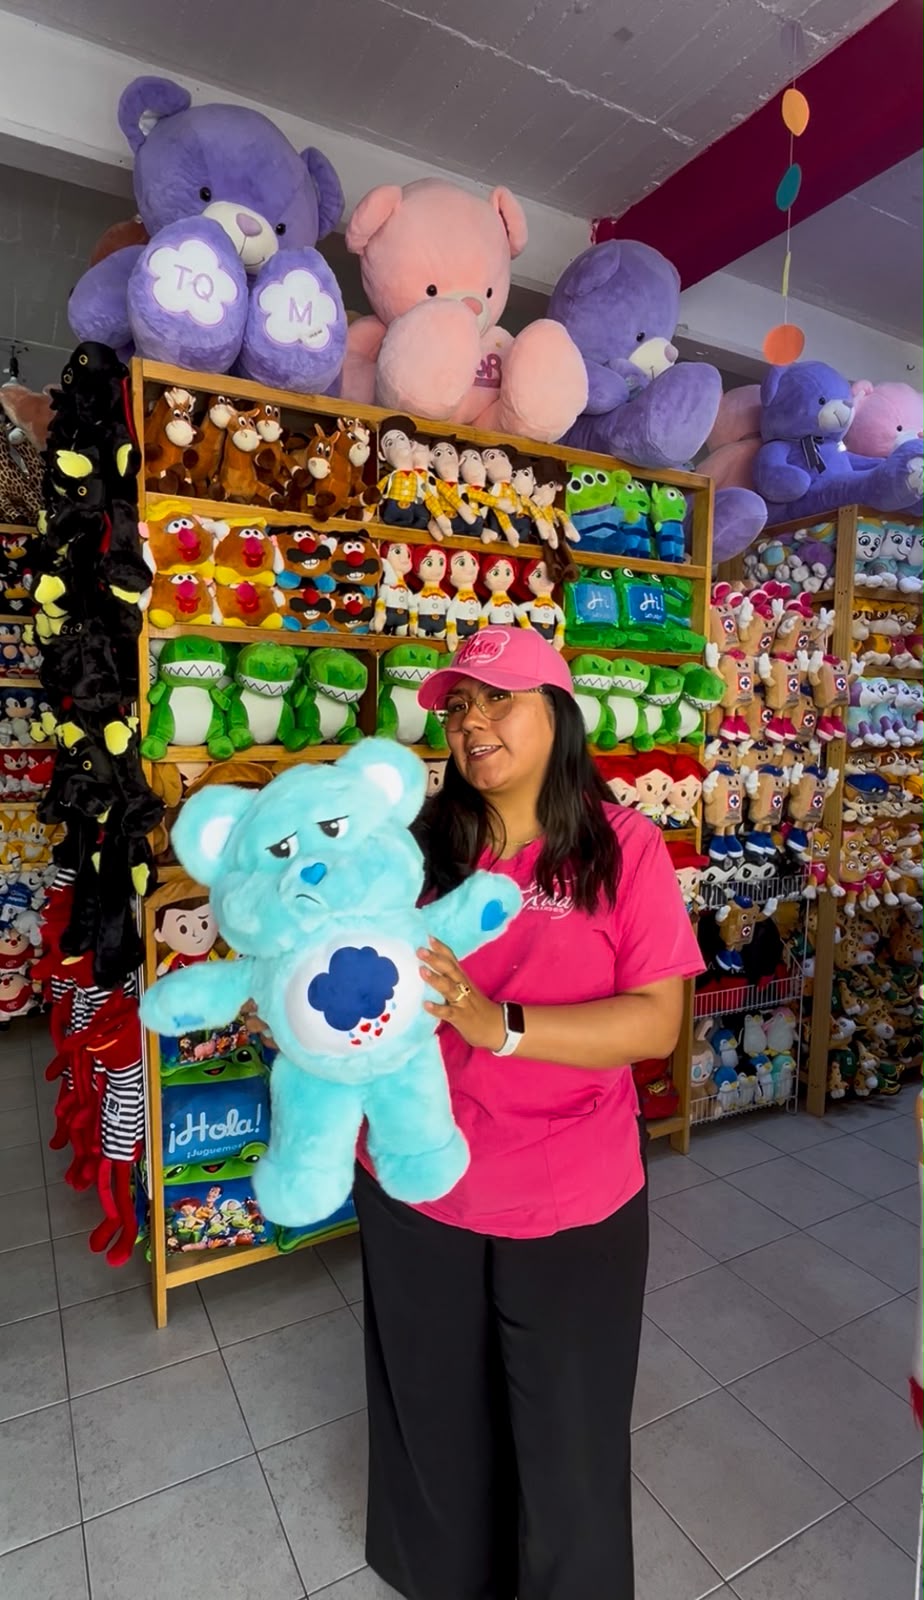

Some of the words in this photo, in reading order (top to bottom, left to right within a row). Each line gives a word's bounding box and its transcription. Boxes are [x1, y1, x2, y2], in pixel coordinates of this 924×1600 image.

[174, 264, 215, 303] TQ
[288, 297, 313, 326] M
[639, 592, 664, 612] Hi!
[168, 1103, 262, 1154] ¡Hola!
